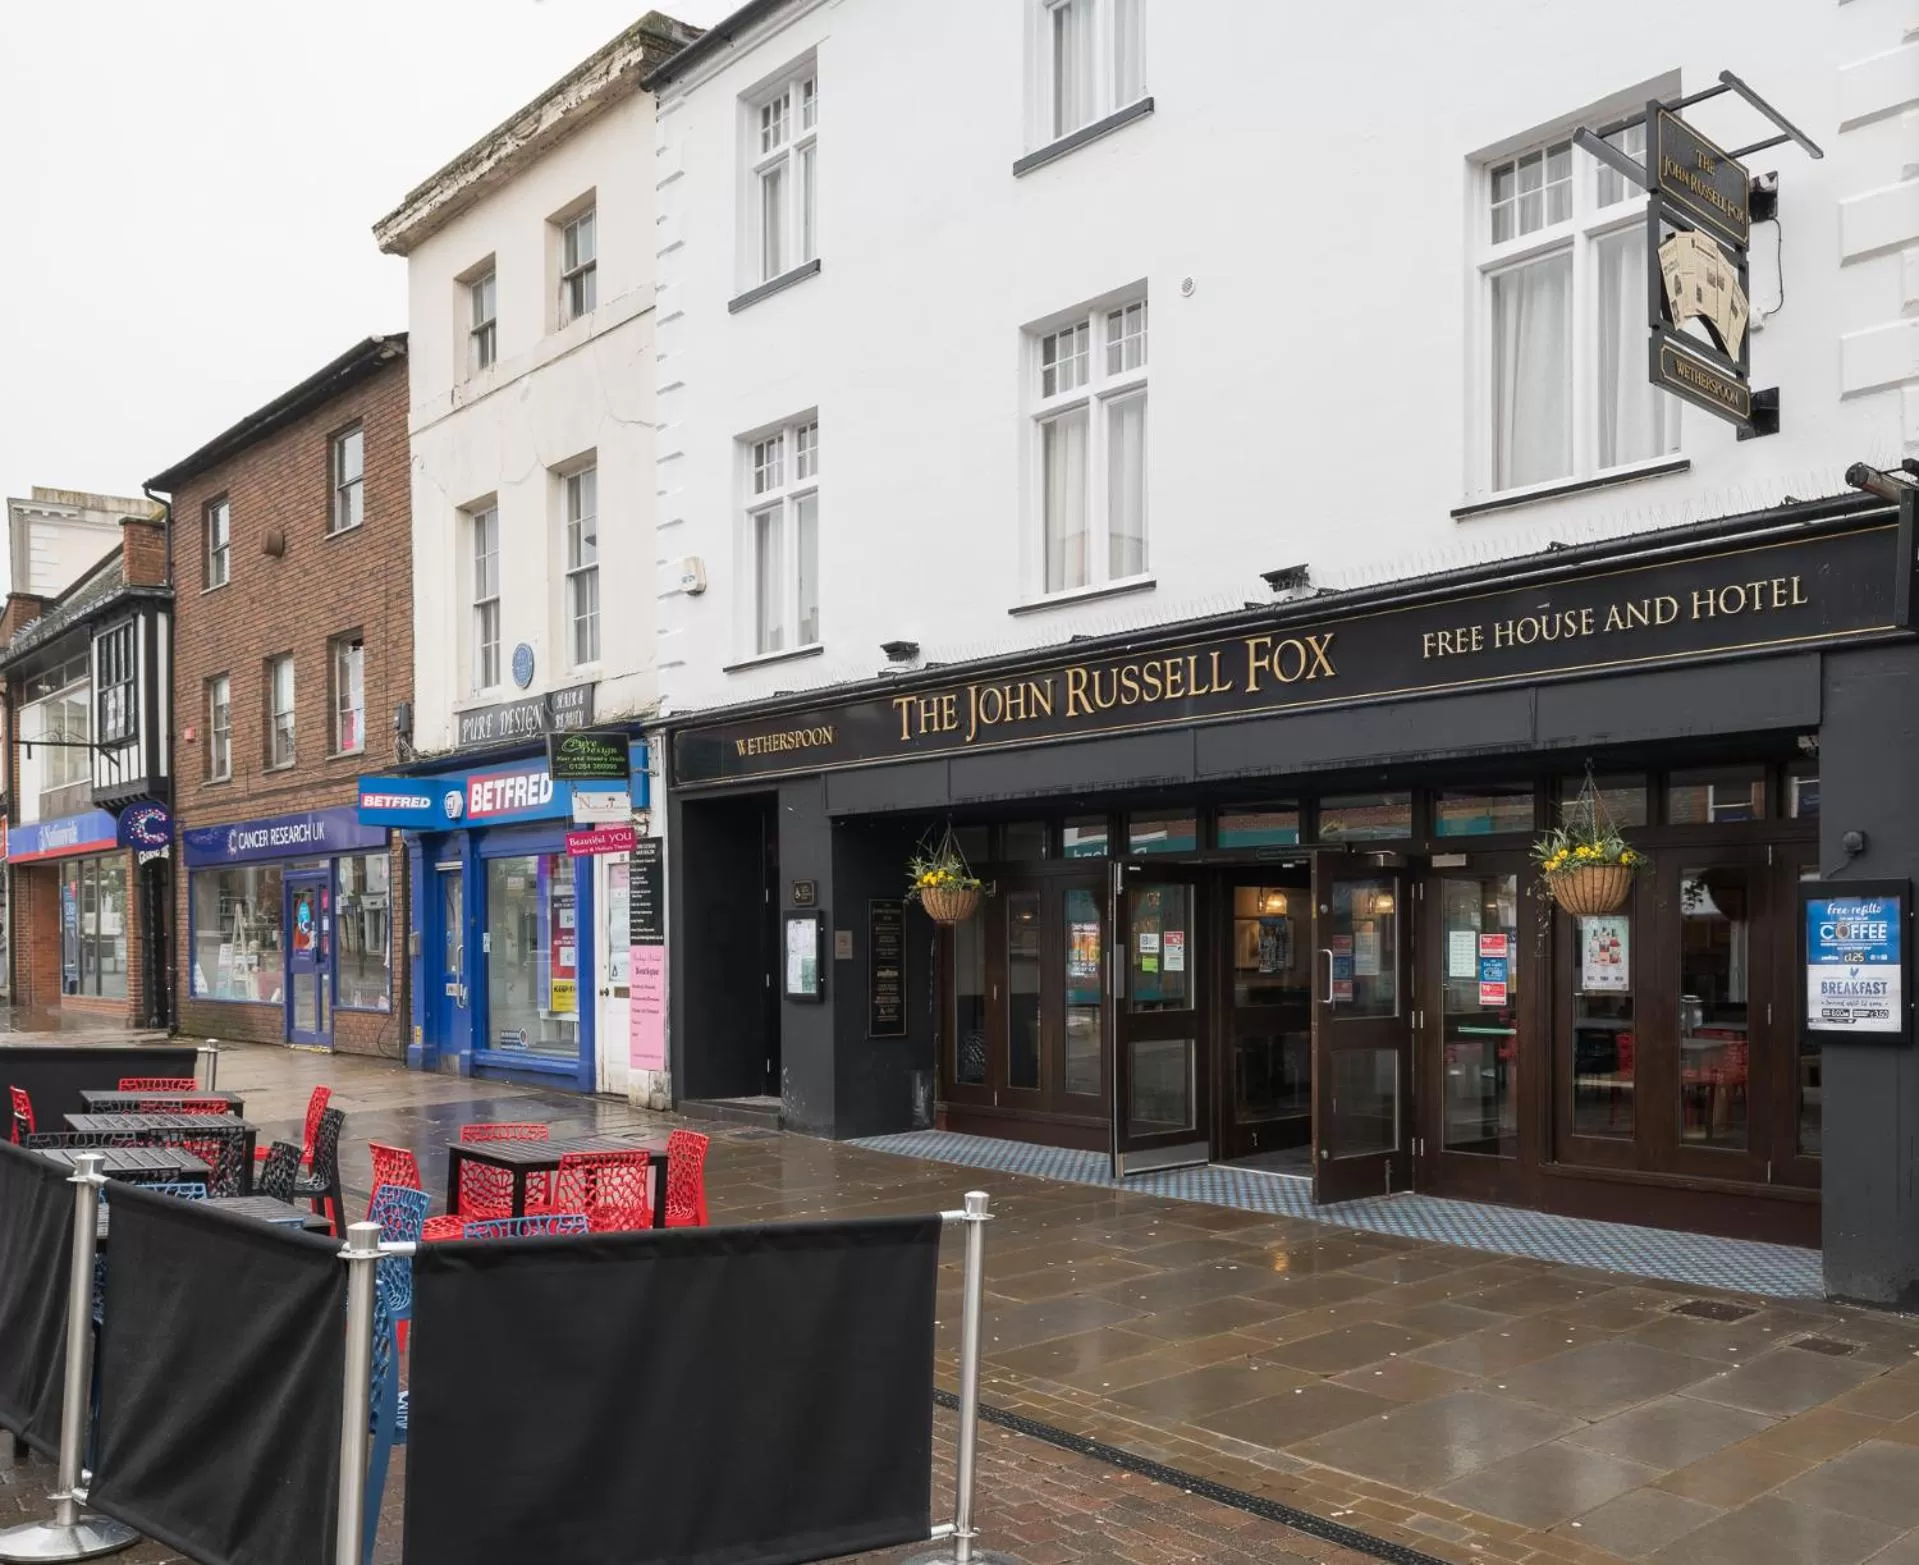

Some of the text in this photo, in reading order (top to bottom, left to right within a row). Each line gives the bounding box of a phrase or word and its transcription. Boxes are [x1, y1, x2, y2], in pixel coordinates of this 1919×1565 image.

[1695, 149, 1716, 176] THE
[1663, 155, 1746, 225] JOHN RUSSELL FOX
[1675, 359, 1739, 405] WETHERSPOON
[1421, 575, 1809, 659] FREE HOUSE AND HOTEL
[892, 632, 1337, 742] THE JOHN RUSSELL FOX
[462, 703, 544, 743] PURE DESIGN
[735, 725, 834, 757] WETHERSPOON
[363, 795, 431, 809] BETFRED
[470, 772, 553, 814] BETFRED
[238, 829, 269, 850] CANCER
[270, 824, 311, 844] RESEARCH
[313, 821, 325, 841] UK
[569, 834, 605, 847] Beautiful
[1820, 923, 1888, 940] COFFEE
[1821, 981, 1888, 995] BREAKFAST
